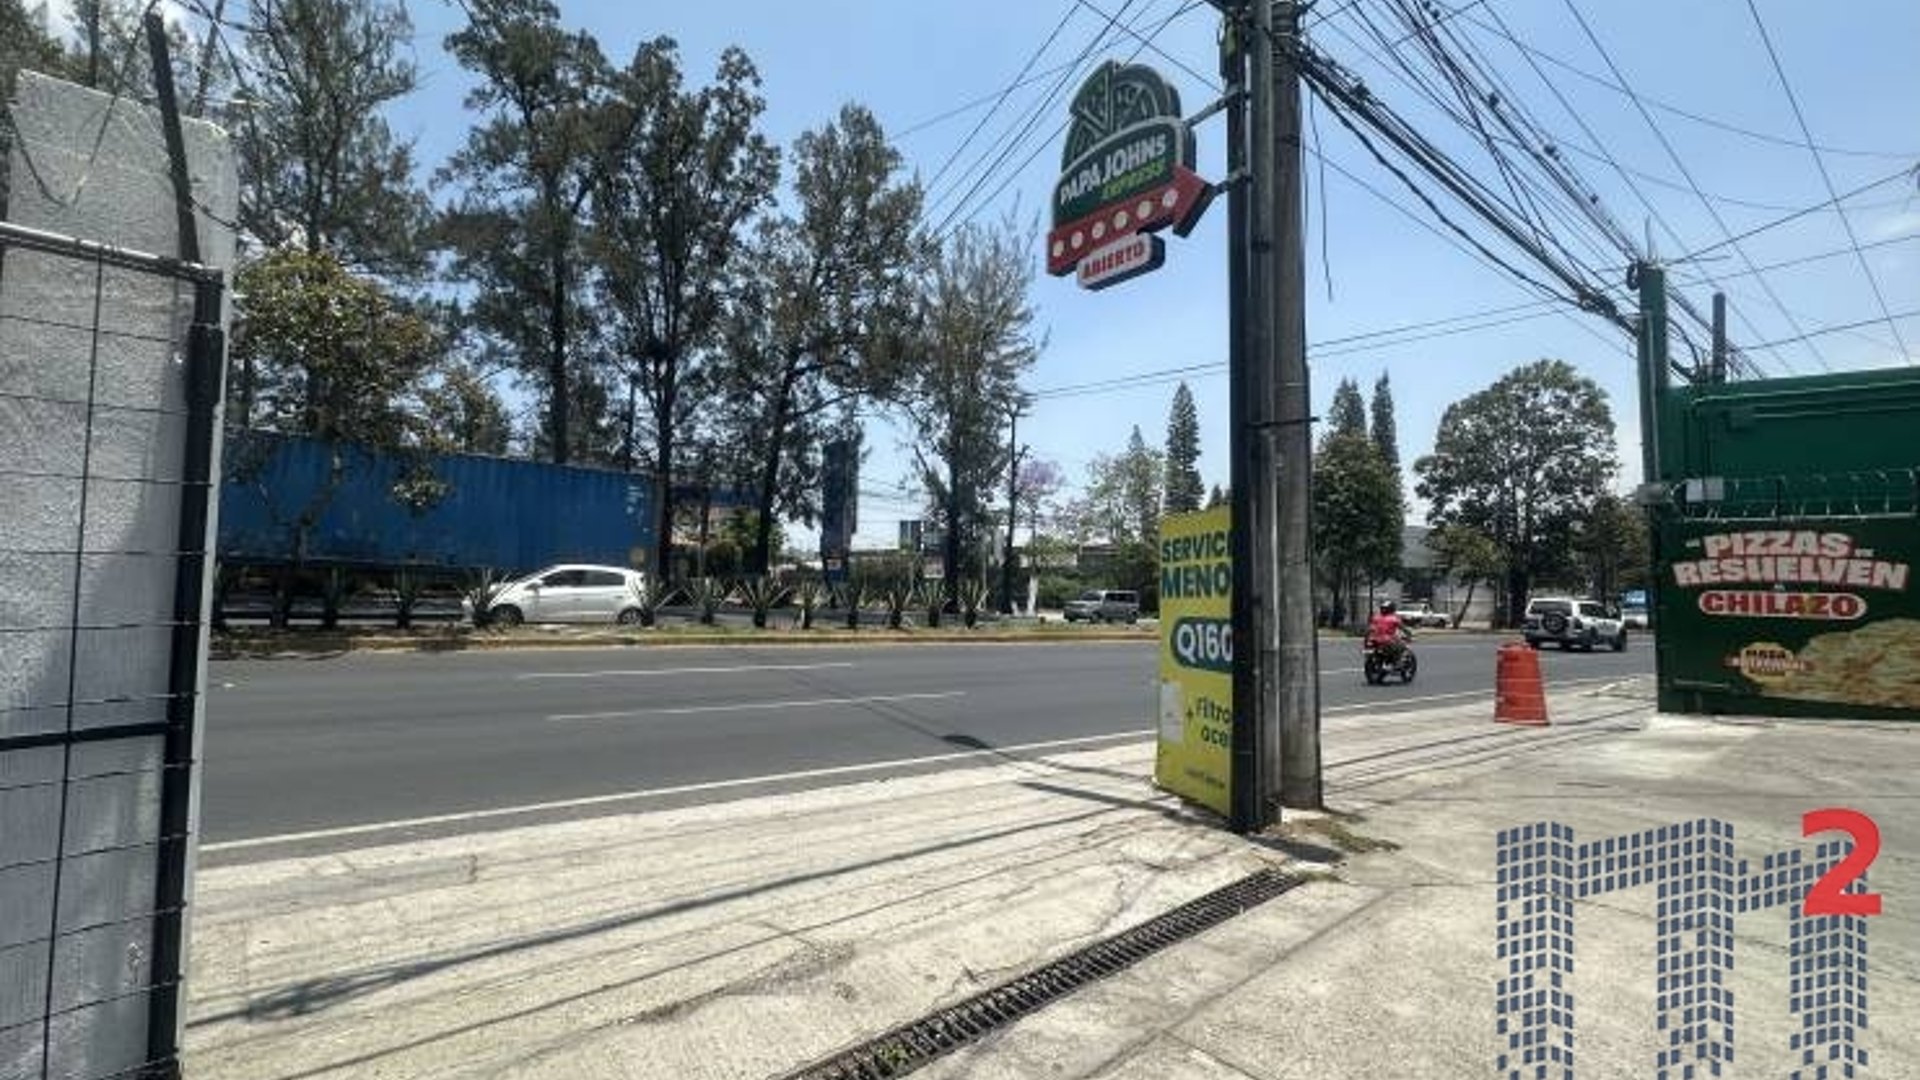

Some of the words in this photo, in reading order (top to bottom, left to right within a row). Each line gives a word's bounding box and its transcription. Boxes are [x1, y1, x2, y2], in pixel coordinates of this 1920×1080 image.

[1060, 162, 1101, 205] PAPA
[1102, 133, 1167, 184] JOHNS
[1081, 240, 1145, 279] ABIERTO
[1703, 530, 1851, 558] PIZZAS
[1673, 556, 1909, 590] RESUELVEN
[1701, 592, 1859, 617] CHILAZO
